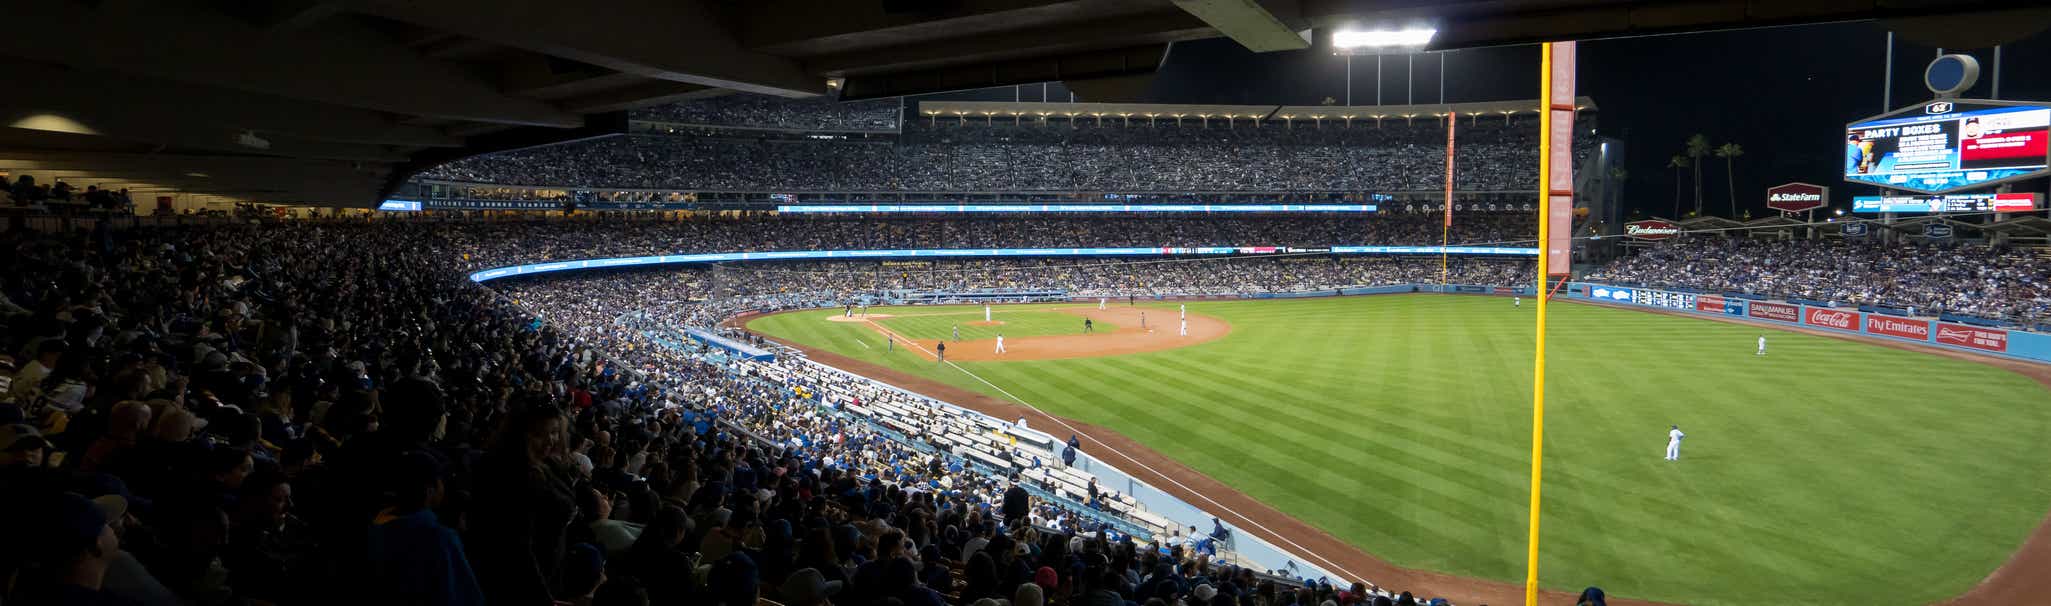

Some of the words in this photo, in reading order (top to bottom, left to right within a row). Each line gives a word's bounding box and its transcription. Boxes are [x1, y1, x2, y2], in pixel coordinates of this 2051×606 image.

[1864, 128, 1899, 138] PARTY
[1902, 124, 1941, 136] BOXES
[1626, 224, 1678, 235] Budweiser
[1751, 303, 1763, 312] SAN
[1767, 306, 1797, 316] MANUEL
[1868, 318, 1884, 330] Fly
[1885, 320, 1928, 336] Emirates
